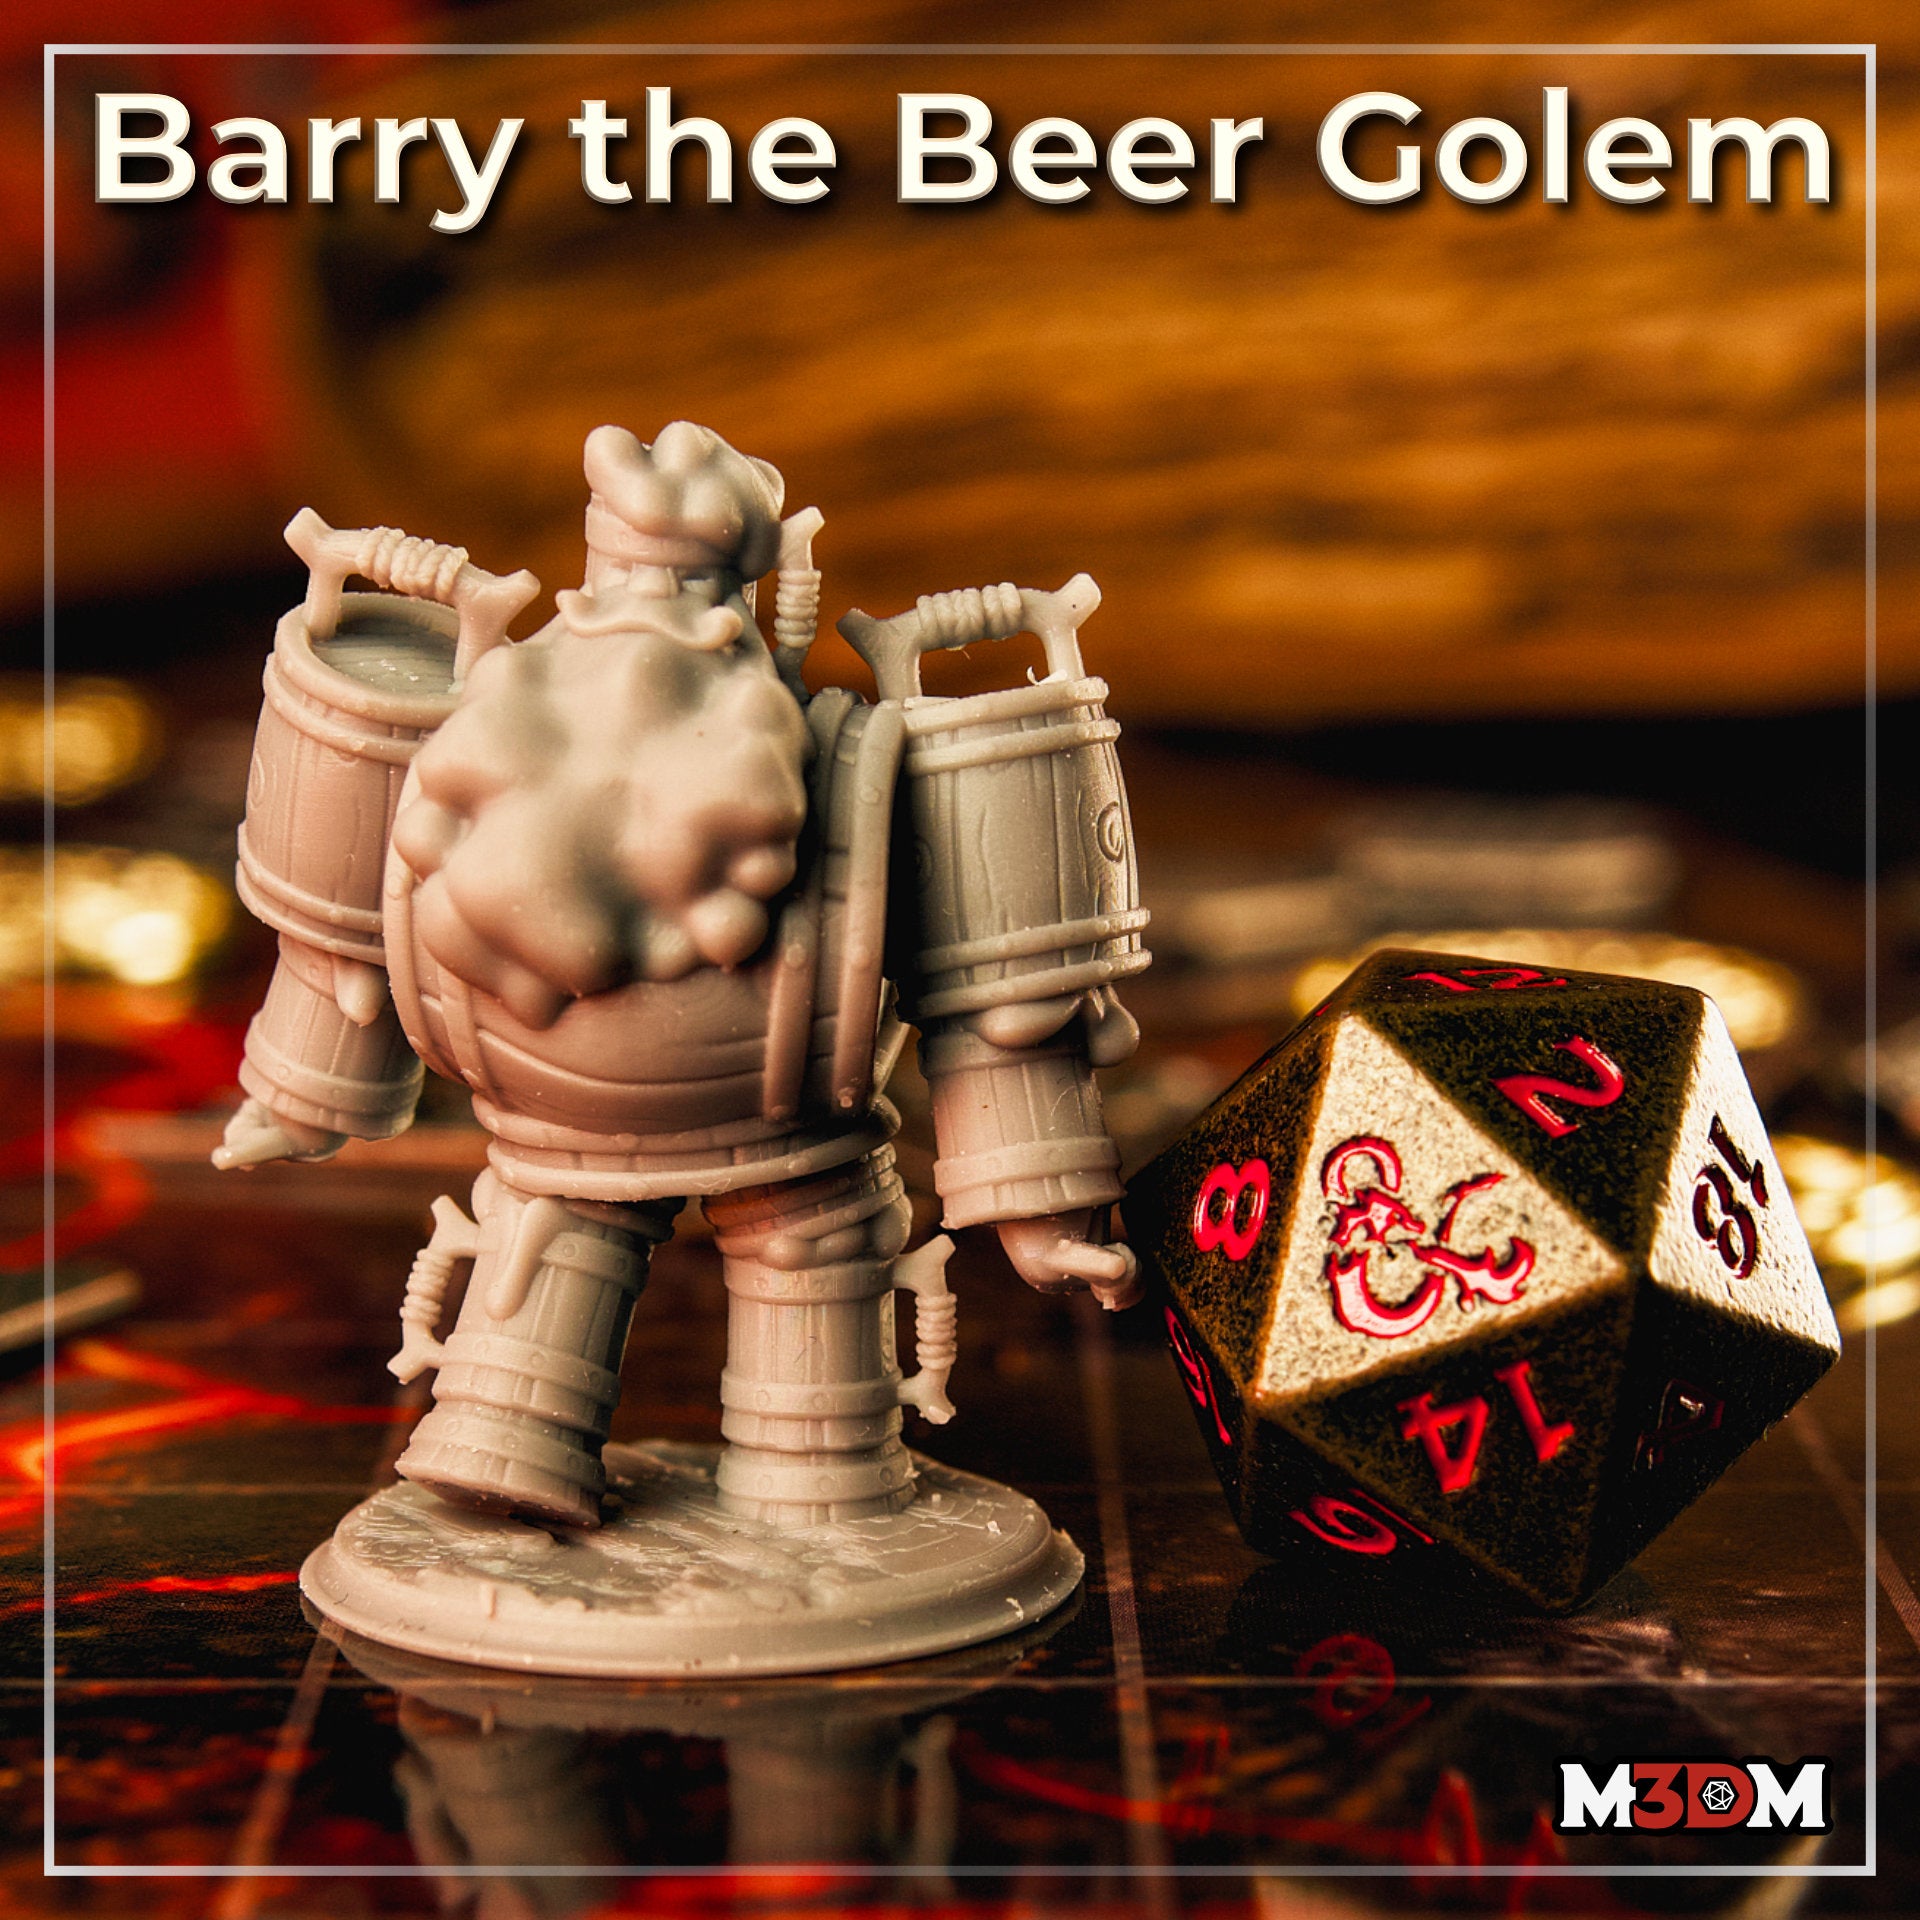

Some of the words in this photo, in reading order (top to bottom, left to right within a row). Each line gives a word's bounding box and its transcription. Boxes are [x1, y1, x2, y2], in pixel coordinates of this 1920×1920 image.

[1494, 1034, 1626, 1138] 2
[1193, 1157, 1271, 1262] 8
[1691, 1111, 1770, 1281] 18
[1395, 1360, 1576, 1495] 14
